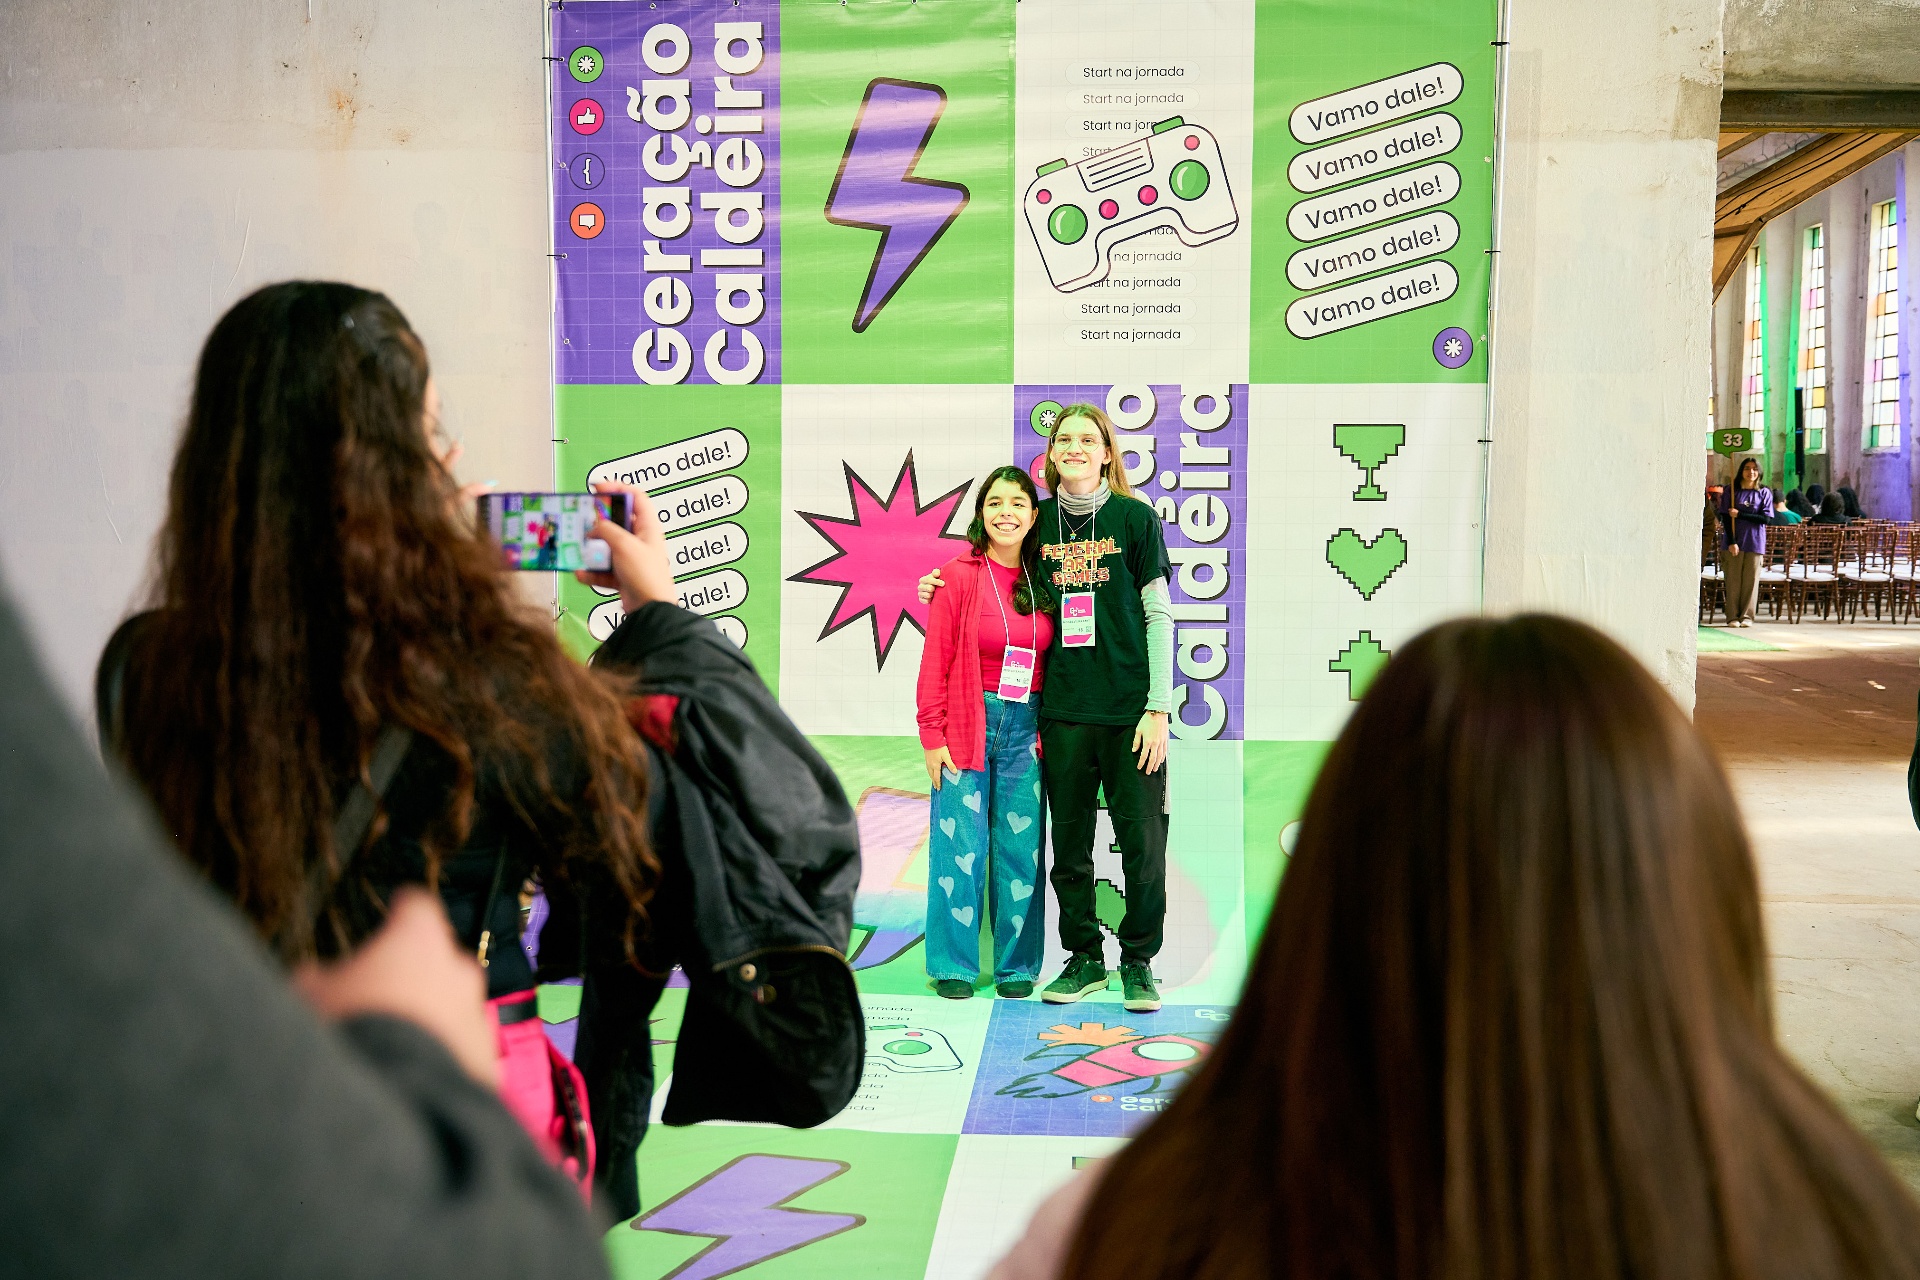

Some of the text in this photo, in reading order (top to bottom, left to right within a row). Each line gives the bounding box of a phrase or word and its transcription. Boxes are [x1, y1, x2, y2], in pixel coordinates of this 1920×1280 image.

[1083, 66, 1185, 80] Start na jornada
[1083, 92, 1184, 107] Start na jornada
[1307, 76, 1445, 132] Vamo dale!
[1083, 120, 1112, 131] Start
[1115, 121, 1131, 130] na
[1306, 125, 1444, 180] Vamo dale!
[626, 22, 712, 385] Geração
[695, 22, 765, 385] Caldeira
[1305, 175, 1443, 229] Vamo dale!
[1114, 250, 1182, 265] na jornada
[1304, 224, 1441, 278] Vamo dale!
[1113, 278, 1130, 287] na
[1132, 276, 1181, 291] jornada
[1081, 302, 1181, 317] Start na jornada
[1303, 273, 1440, 327] Vamo dale!
[1080, 328, 1181, 343] Start na jornada
[1722, 433, 1744, 447] 33
[676, 440, 732, 471] dale!
[676, 487, 732, 518] dale!
[675, 534, 732, 565] dale!
[1041, 538, 1122, 560] FEDERAL
[1062, 554, 1101, 571] ART
[1160, 384, 1231, 741] Caldeira
[1052, 567, 1110, 585] GAMES
